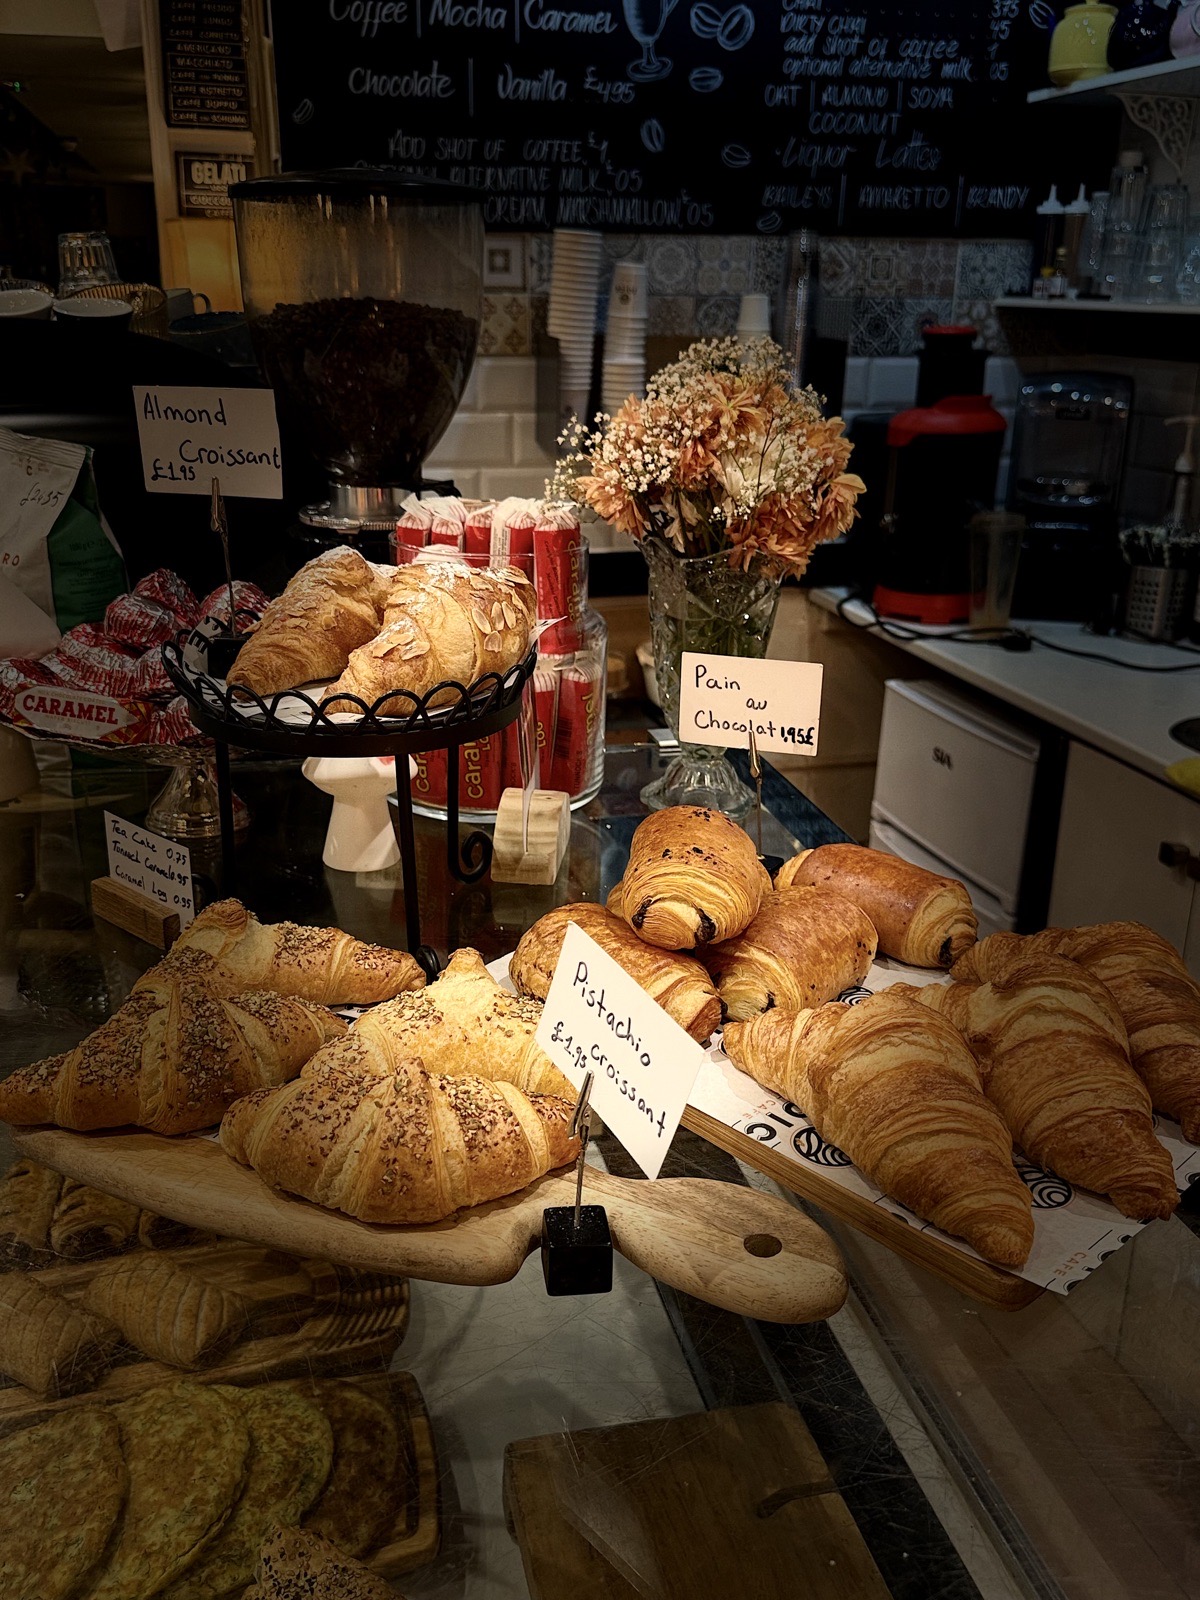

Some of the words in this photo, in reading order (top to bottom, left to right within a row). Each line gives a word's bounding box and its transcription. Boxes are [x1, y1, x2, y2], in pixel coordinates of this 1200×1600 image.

[330, 0, 409, 38] Coffee
[429, 0, 506, 29] Mocha
[523, 0, 617, 33] Caramel
[348, 60, 456, 98] Chocolate
[763, 84, 802, 107] OAT
[808, 111, 902, 135] COCONUT
[388, 129, 426, 160] ADD
[432, 136, 478, 161] SHOT
[481, 138, 506, 161] OF
[144, 392, 226, 425] Almond
[179, 439, 280, 469] Croissant
[695, 664, 741, 691] Pain
[23, 694, 119, 725] CARAMEL
[745, 697, 768, 710] au
[694, 709, 777, 738] Chocolat
[416, 752, 431, 792] Car
[464, 742, 484, 799] Cara
[111, 820, 128, 839] Tea
[132, 832, 157, 853] Cake
[166, 848, 187, 865] 0.75
[115, 865, 146, 890] Caramel
[152, 882, 168, 903] Log
[173, 895, 192, 909] 0.95
[573, 961, 651, 1067] Pistachio
[590, 1044, 666, 1138] Croissant
